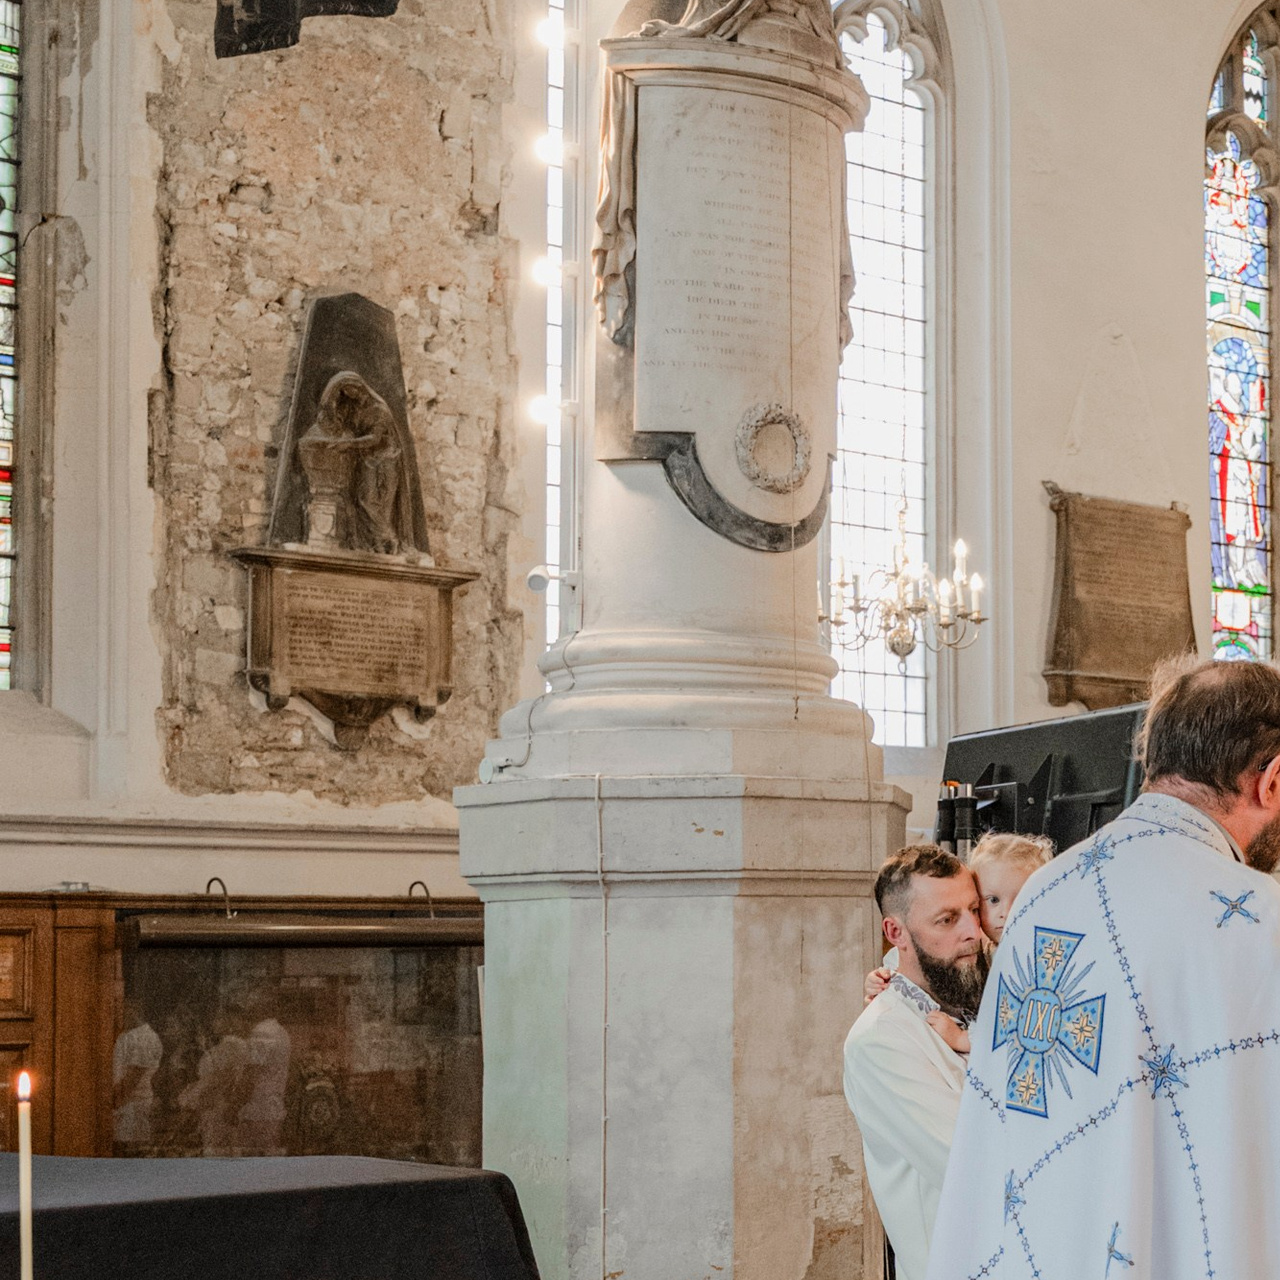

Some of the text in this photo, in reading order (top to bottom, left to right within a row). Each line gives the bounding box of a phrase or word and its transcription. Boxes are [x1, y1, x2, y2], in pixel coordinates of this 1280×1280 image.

[684, 279, 707, 287] THE
[712, 281, 745, 291] WARD
[715, 314, 739, 322] THE
